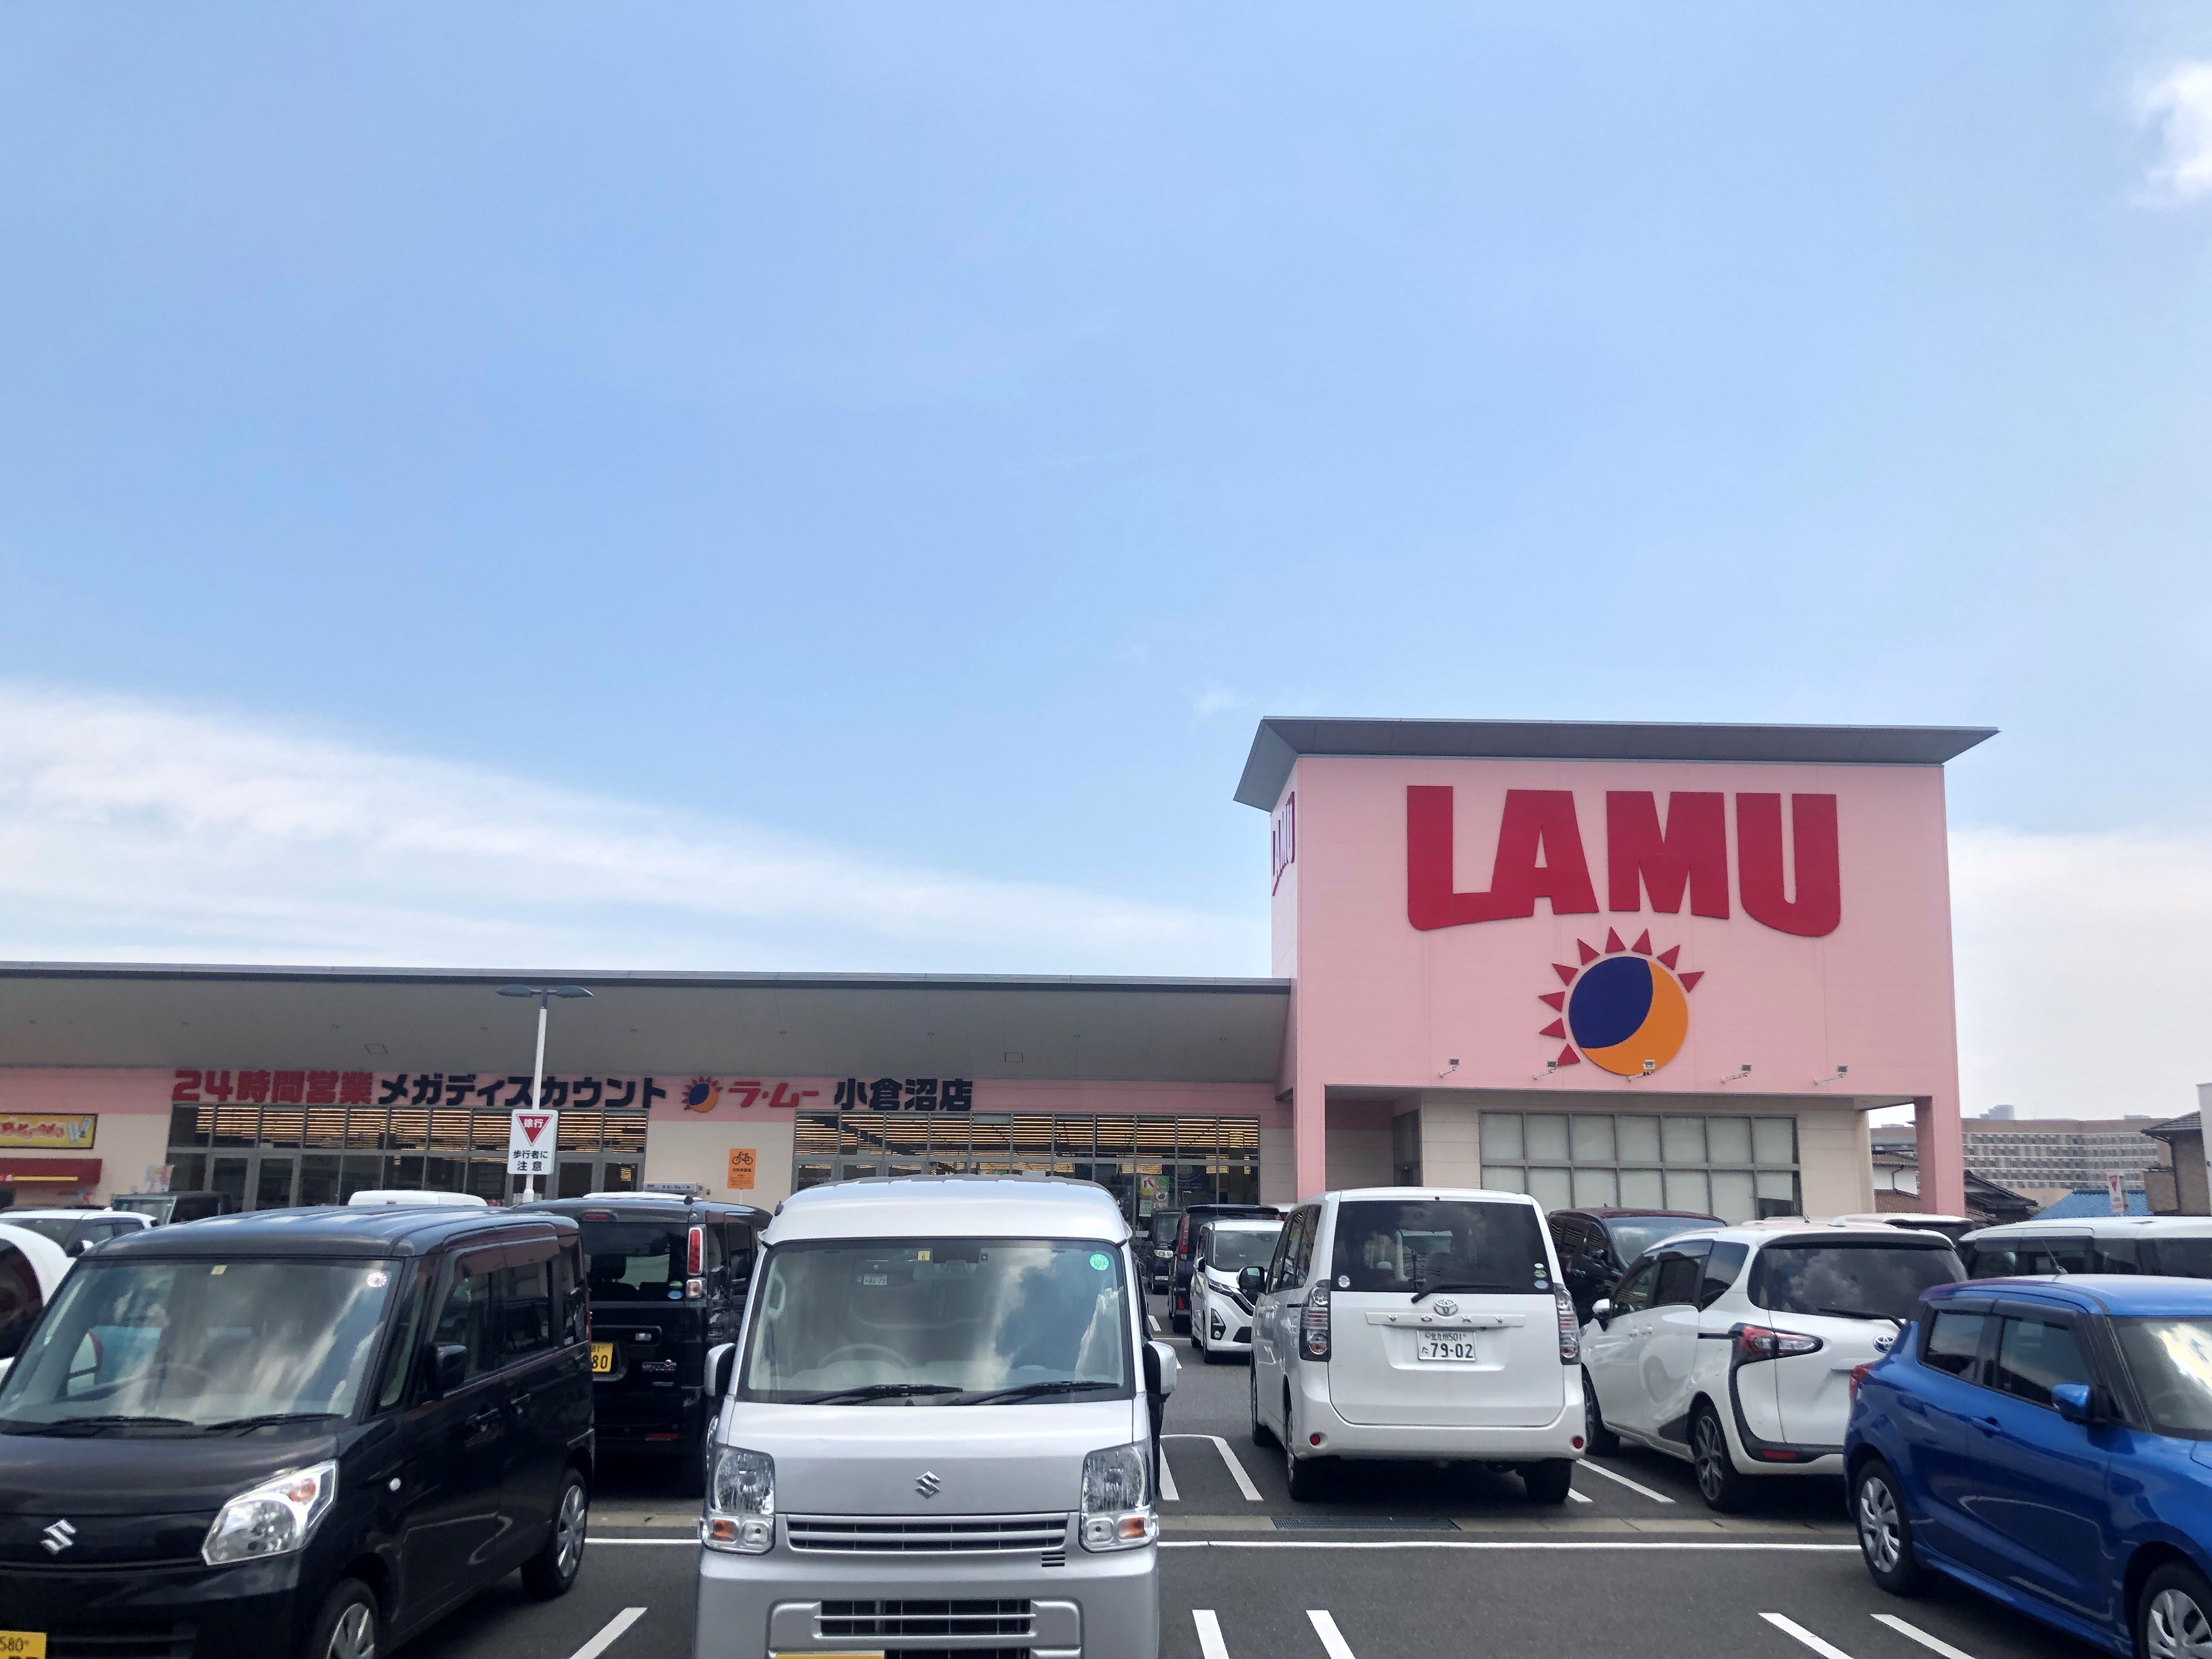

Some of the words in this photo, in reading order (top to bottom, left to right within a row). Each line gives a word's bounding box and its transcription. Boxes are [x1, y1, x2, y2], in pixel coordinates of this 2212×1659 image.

[1407, 785, 1841, 937] LAMU
[172, 1069, 373, 1104] 24時間営業
[379, 1073, 666, 1109] メガディスカウント
[834, 1078, 973, 1110] 小倉沼店
[524, 1118, 544, 1128] 徐行
[513, 1150, 548, 1159] 歩行者に
[517, 1161, 542, 1171] 注意
[1387, 1314, 1504, 1323] VOXY
[1430, 1342, 1474, 1358] 79-02
